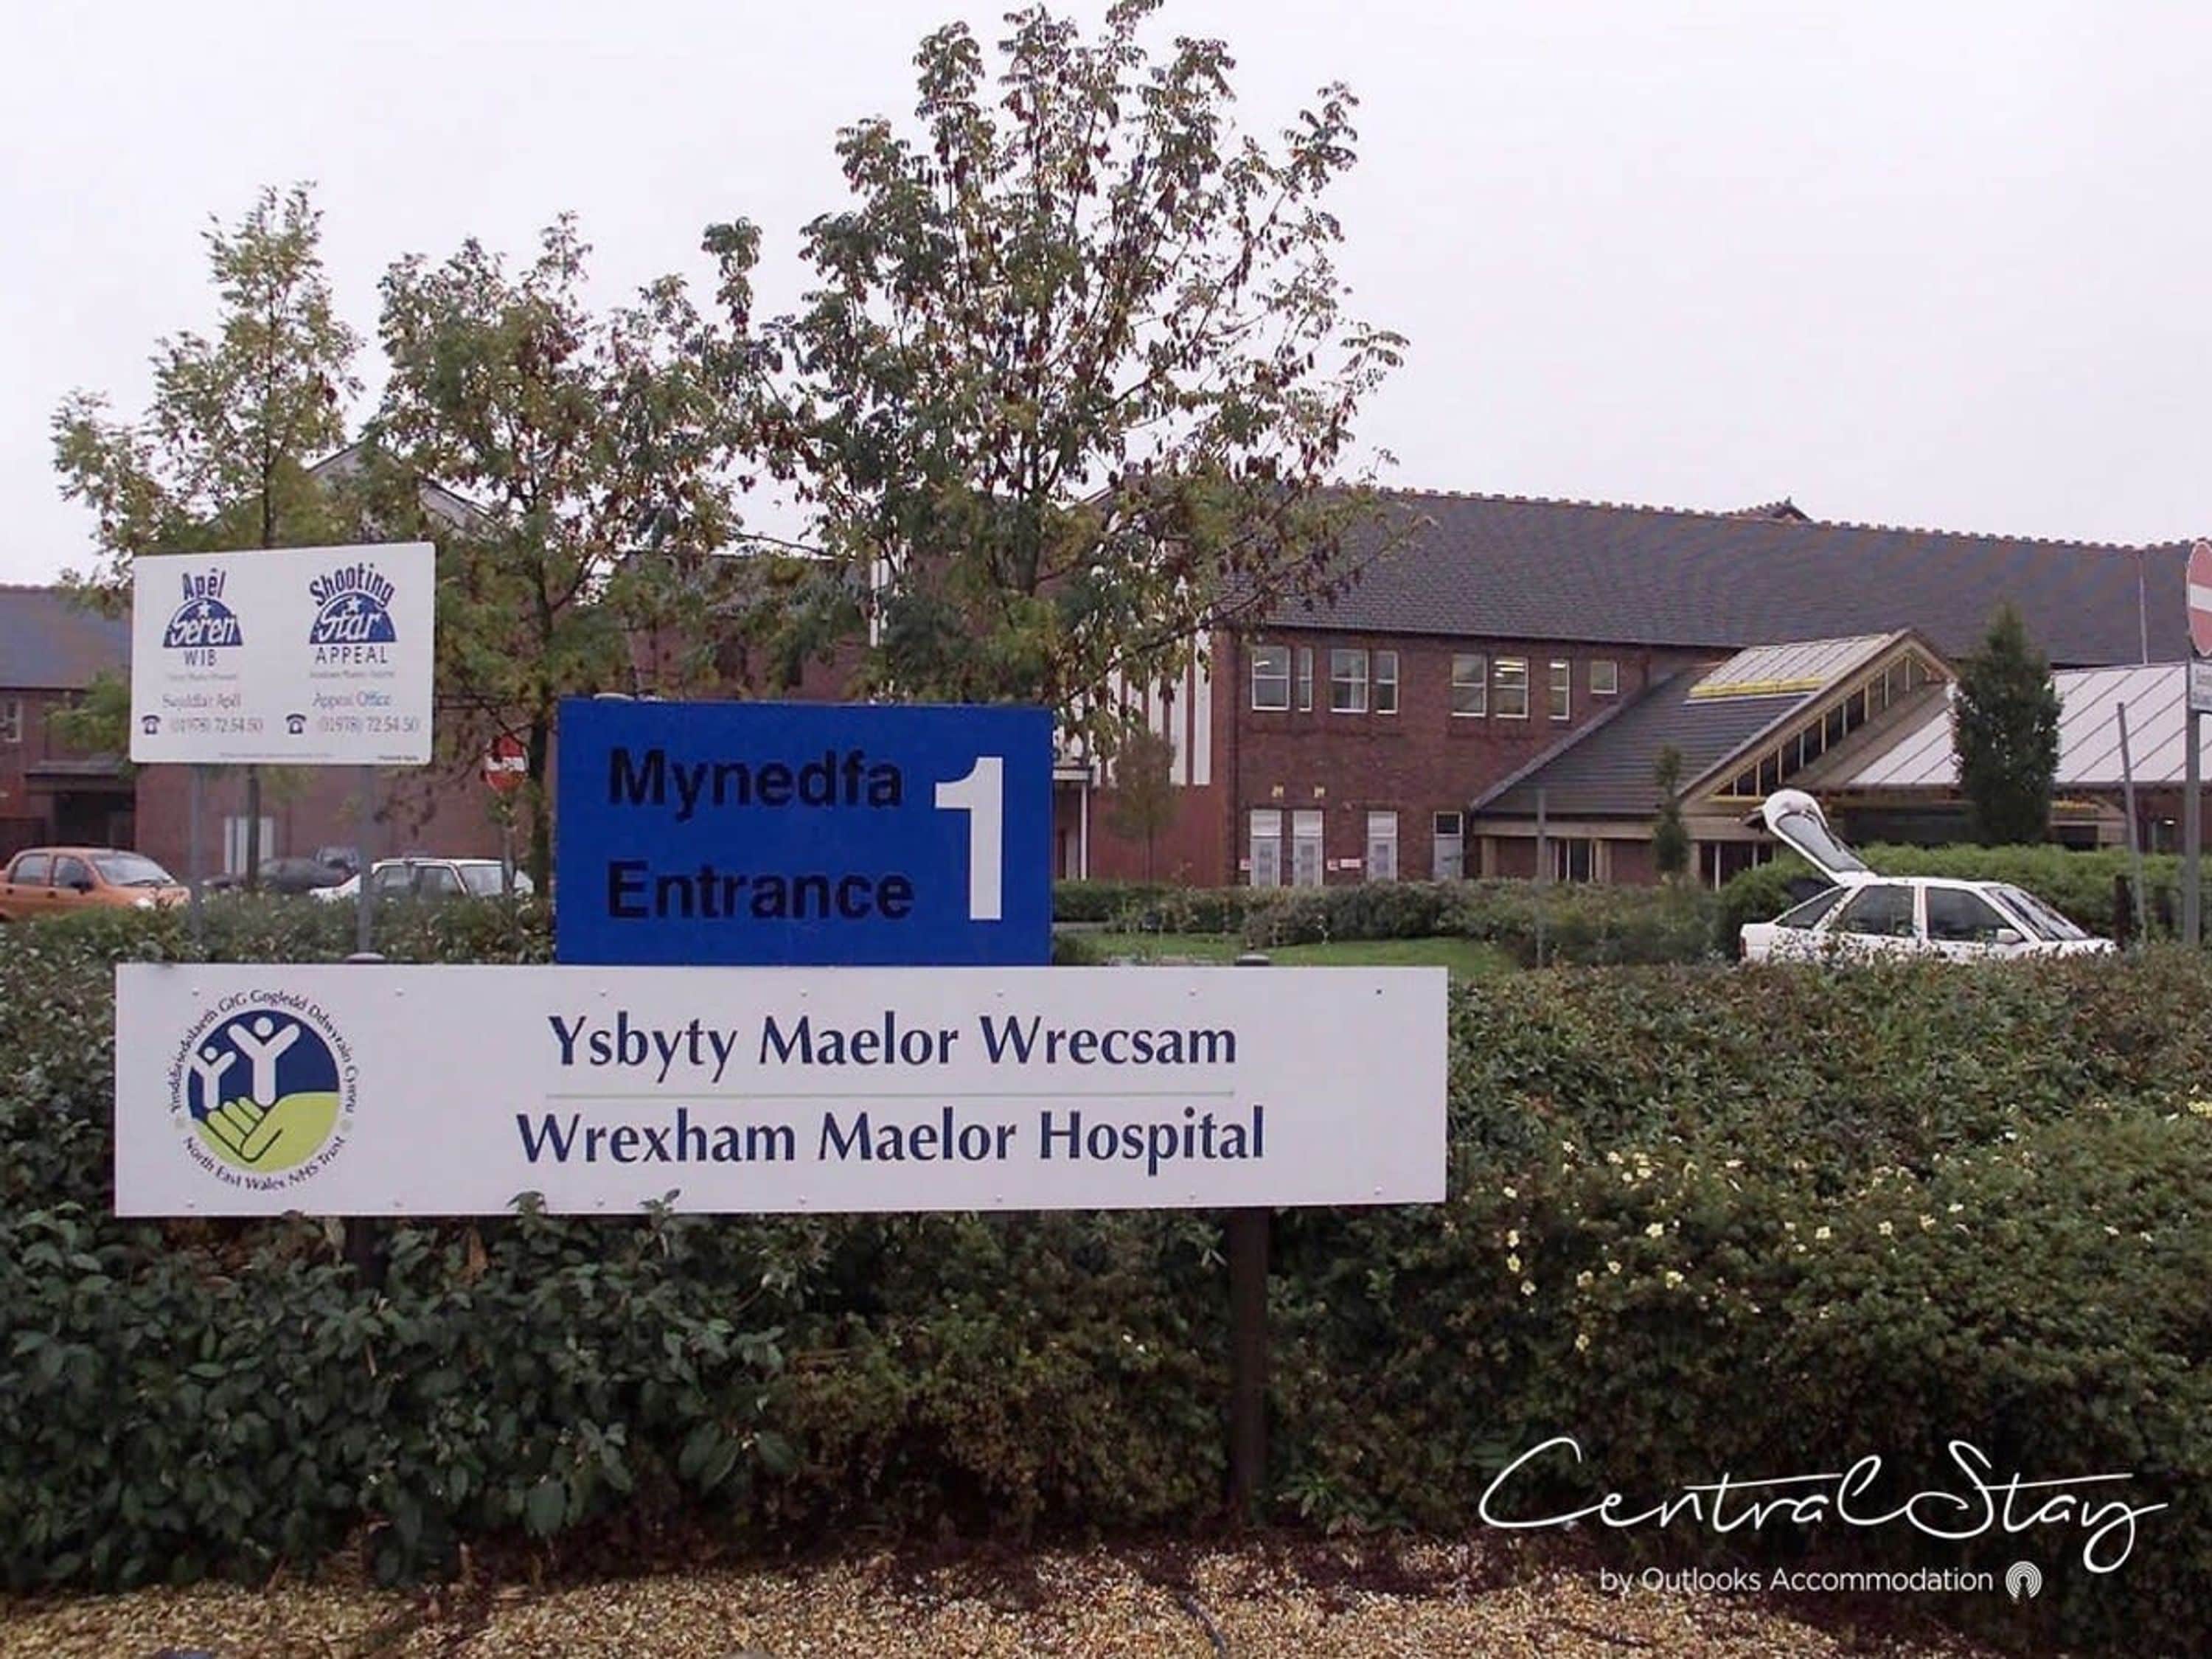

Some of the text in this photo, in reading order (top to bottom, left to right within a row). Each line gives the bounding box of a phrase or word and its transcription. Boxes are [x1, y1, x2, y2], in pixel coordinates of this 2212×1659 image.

[310, 562, 395, 608] Shooting
[170, 616, 236, 647] Seren
[315, 646, 388, 664] APPEAL
[319, 612, 380, 642] Star
[608, 747, 904, 823] Mynedfa
[935, 757, 1004, 921] 1
[608, 860, 915, 920] Entrance
[218, 992, 248, 1012] GIG
[343, 1065, 359, 1113] Cymru
[549, 1011, 1237, 1085] Ysbyty Maelor Wrecsam
[184, 1135, 346, 1192] North East Wales NHS Trust
[516, 1106, 1265, 1178] Wrexham Maelor Hospital
